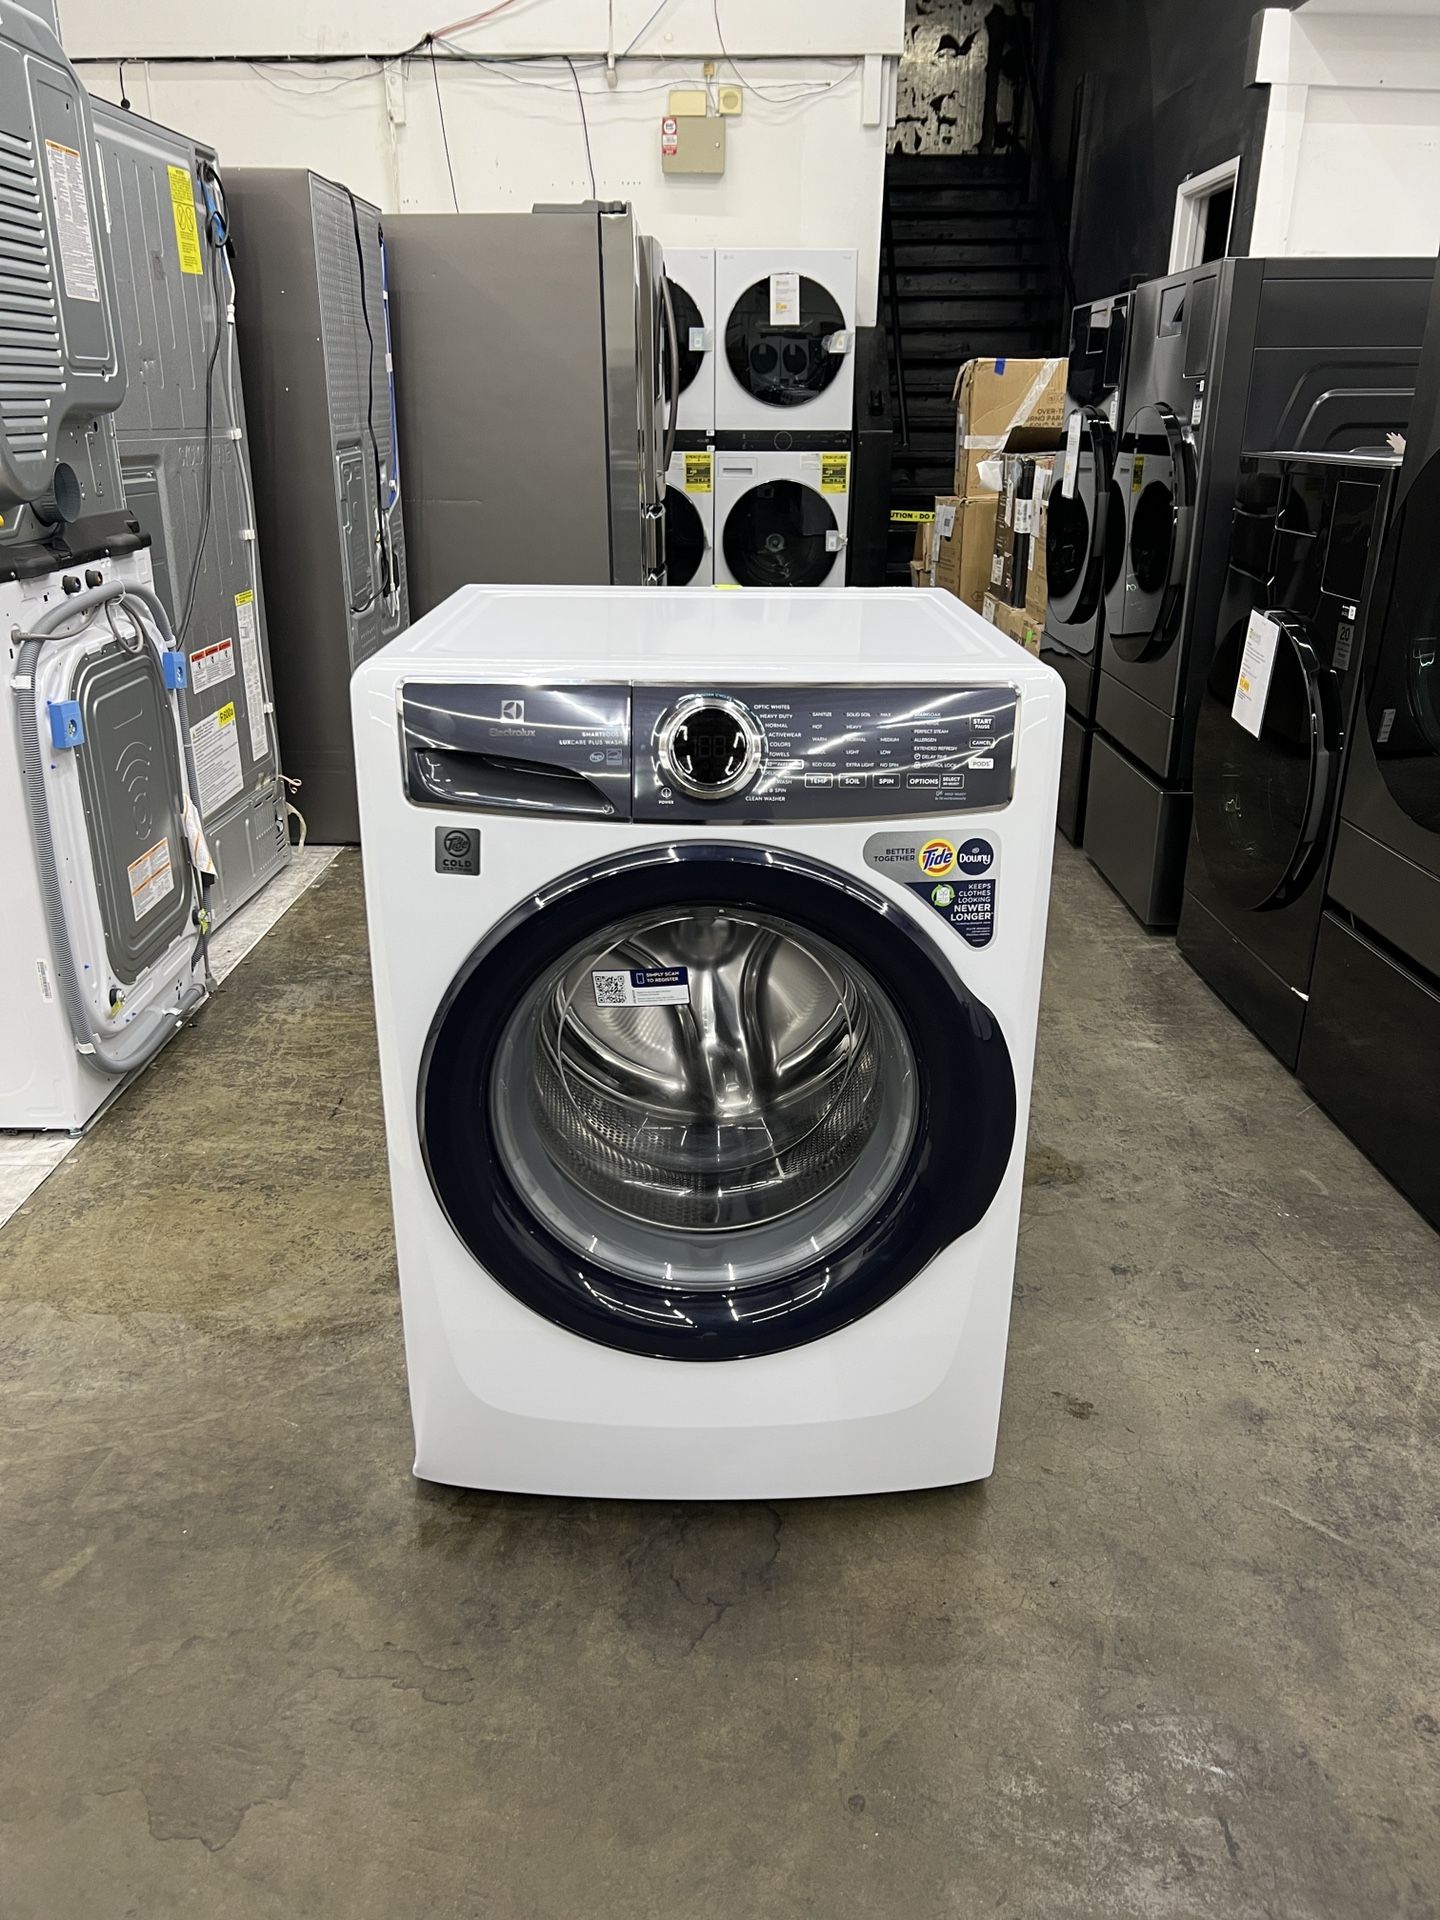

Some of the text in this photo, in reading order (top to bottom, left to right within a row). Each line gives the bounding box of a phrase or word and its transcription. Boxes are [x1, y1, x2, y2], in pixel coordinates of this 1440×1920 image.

[489, 728, 536, 738] Electrolux
[443, 859, 472, 867] COLD
[922, 846, 953, 871] Tide
[959, 854, 991, 864] Downy
[954, 904, 991, 912] NEWER
